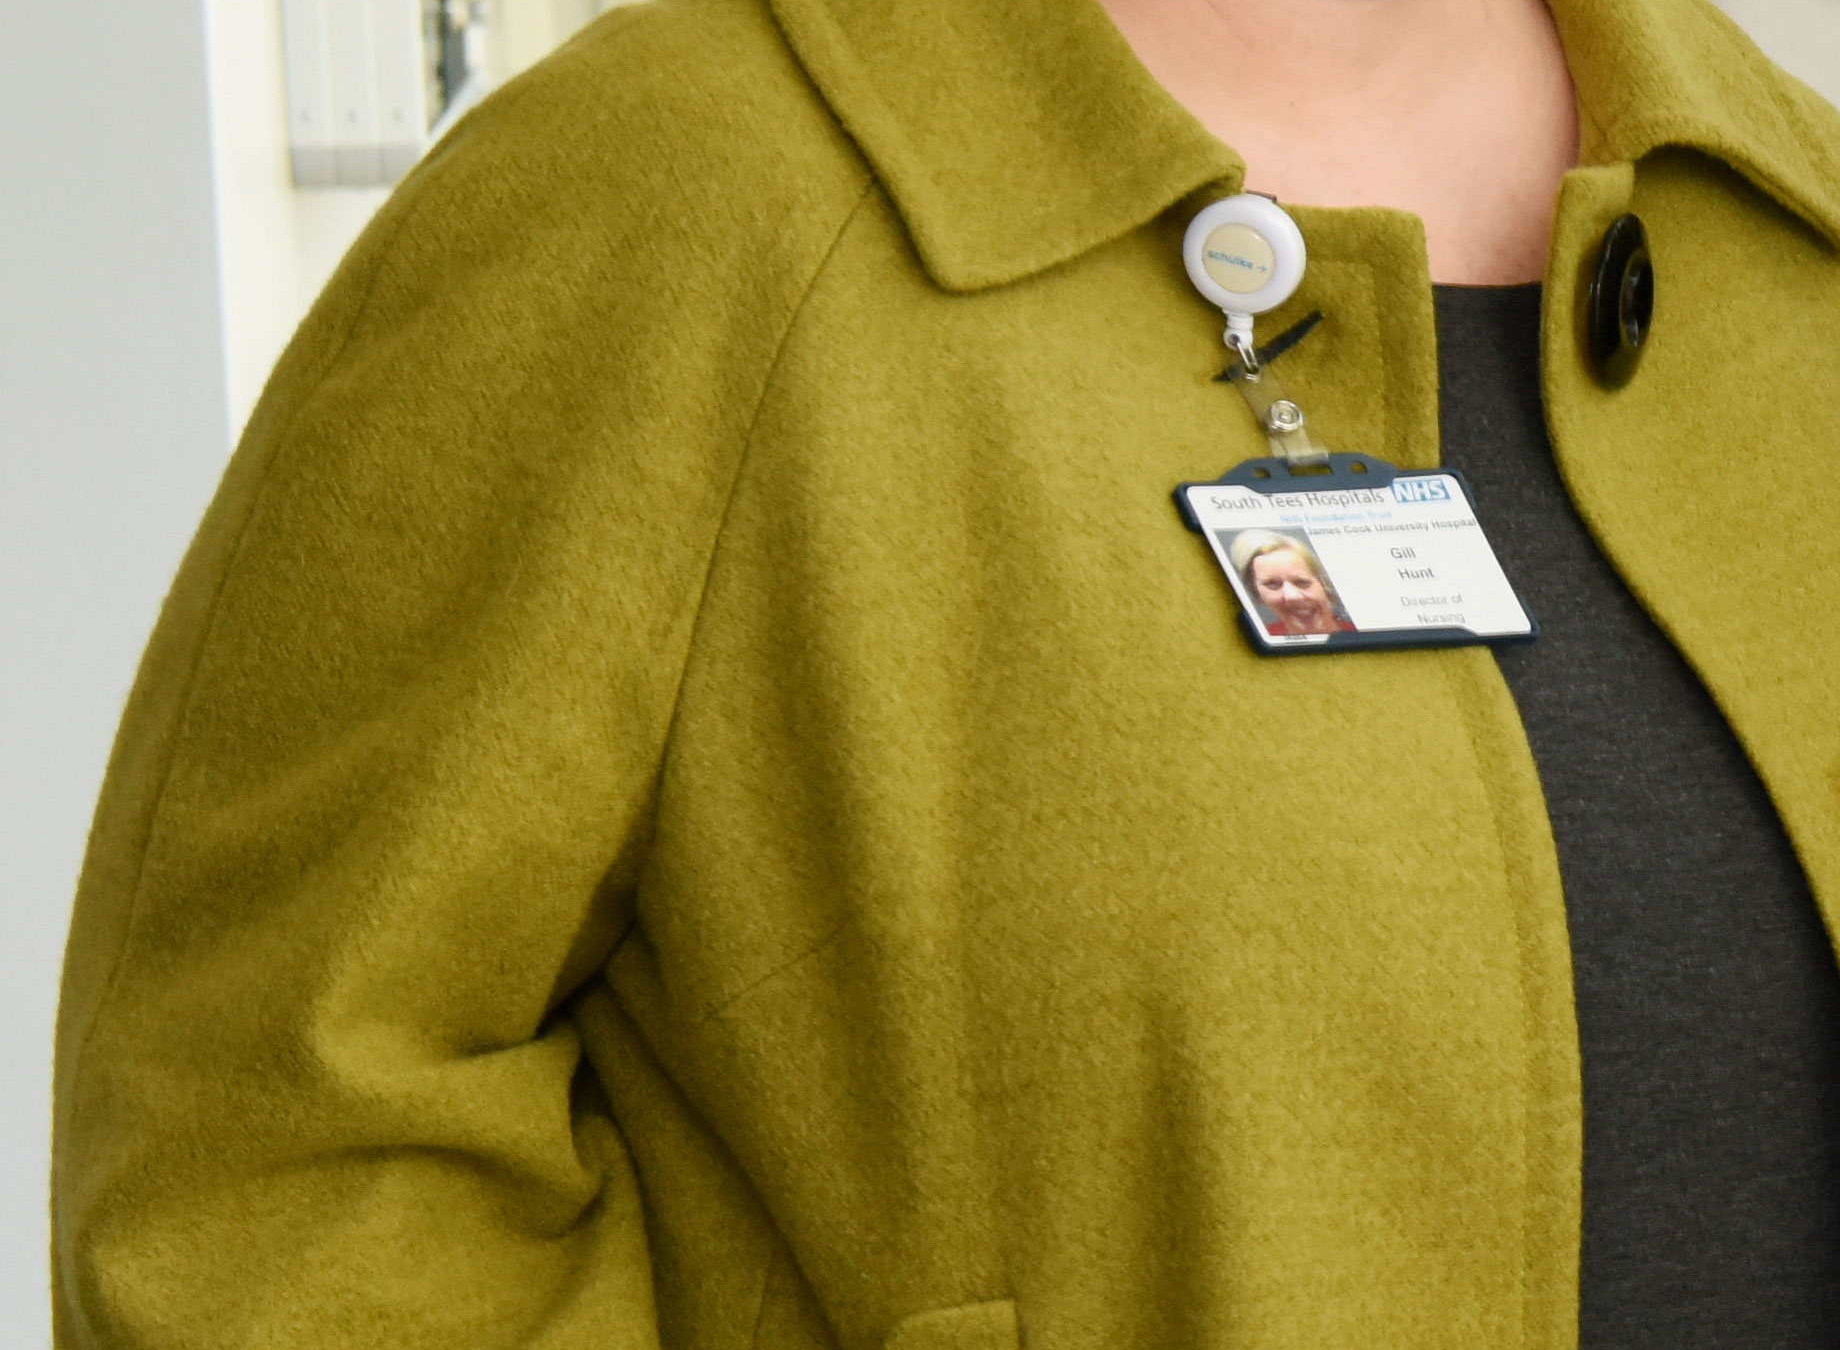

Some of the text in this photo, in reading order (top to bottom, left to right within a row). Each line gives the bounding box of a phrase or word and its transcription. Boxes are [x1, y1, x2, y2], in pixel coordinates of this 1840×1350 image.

[1393, 479, 1449, 501] NHS
[1211, 488, 1385, 511] South Tees Hospitals
[1343, 524, 1372, 534] Cook
[1374, 521, 1430, 533] University
[1390, 547, 1416, 559] Gill
[1397, 567, 1436, 580] Hunt
